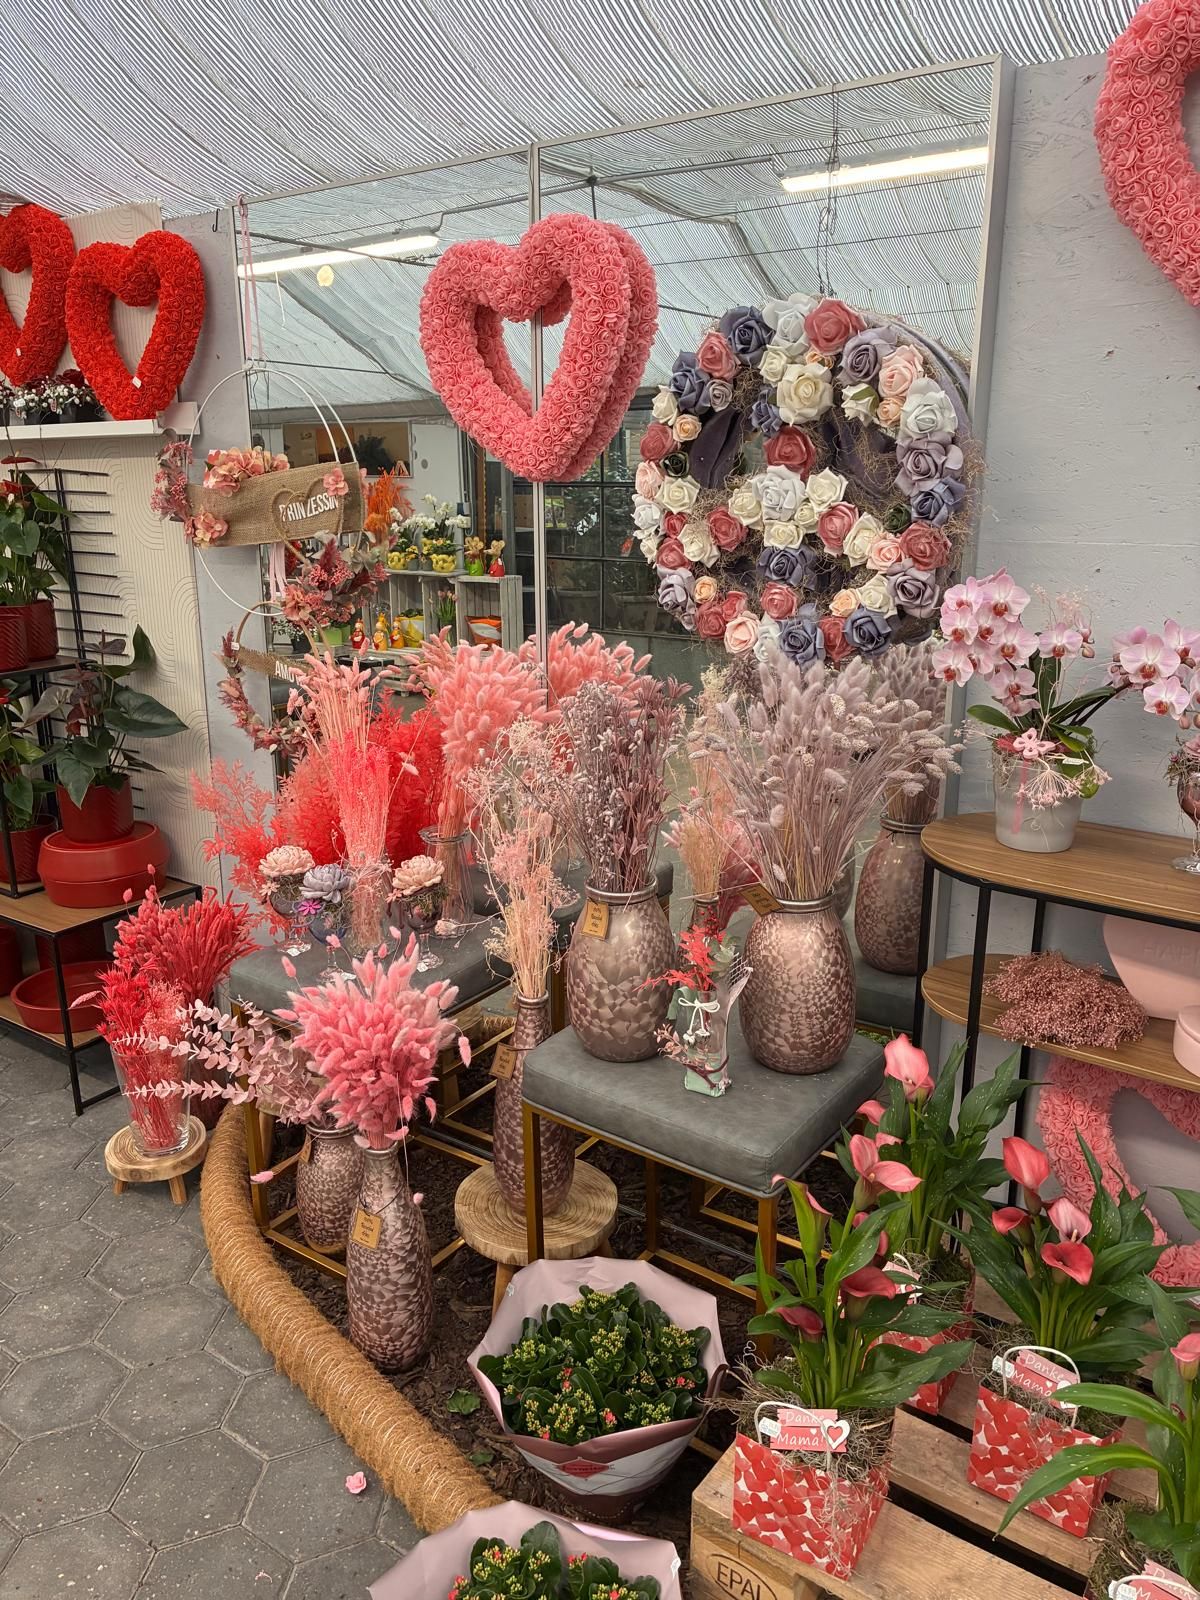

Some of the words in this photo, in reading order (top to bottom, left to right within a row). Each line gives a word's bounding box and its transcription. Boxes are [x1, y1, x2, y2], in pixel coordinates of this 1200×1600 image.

[274, 660, 301, 686] AMO
[1025, 1353, 1065, 1381] Danke
[1011, 1369, 1053, 1398] Mama
